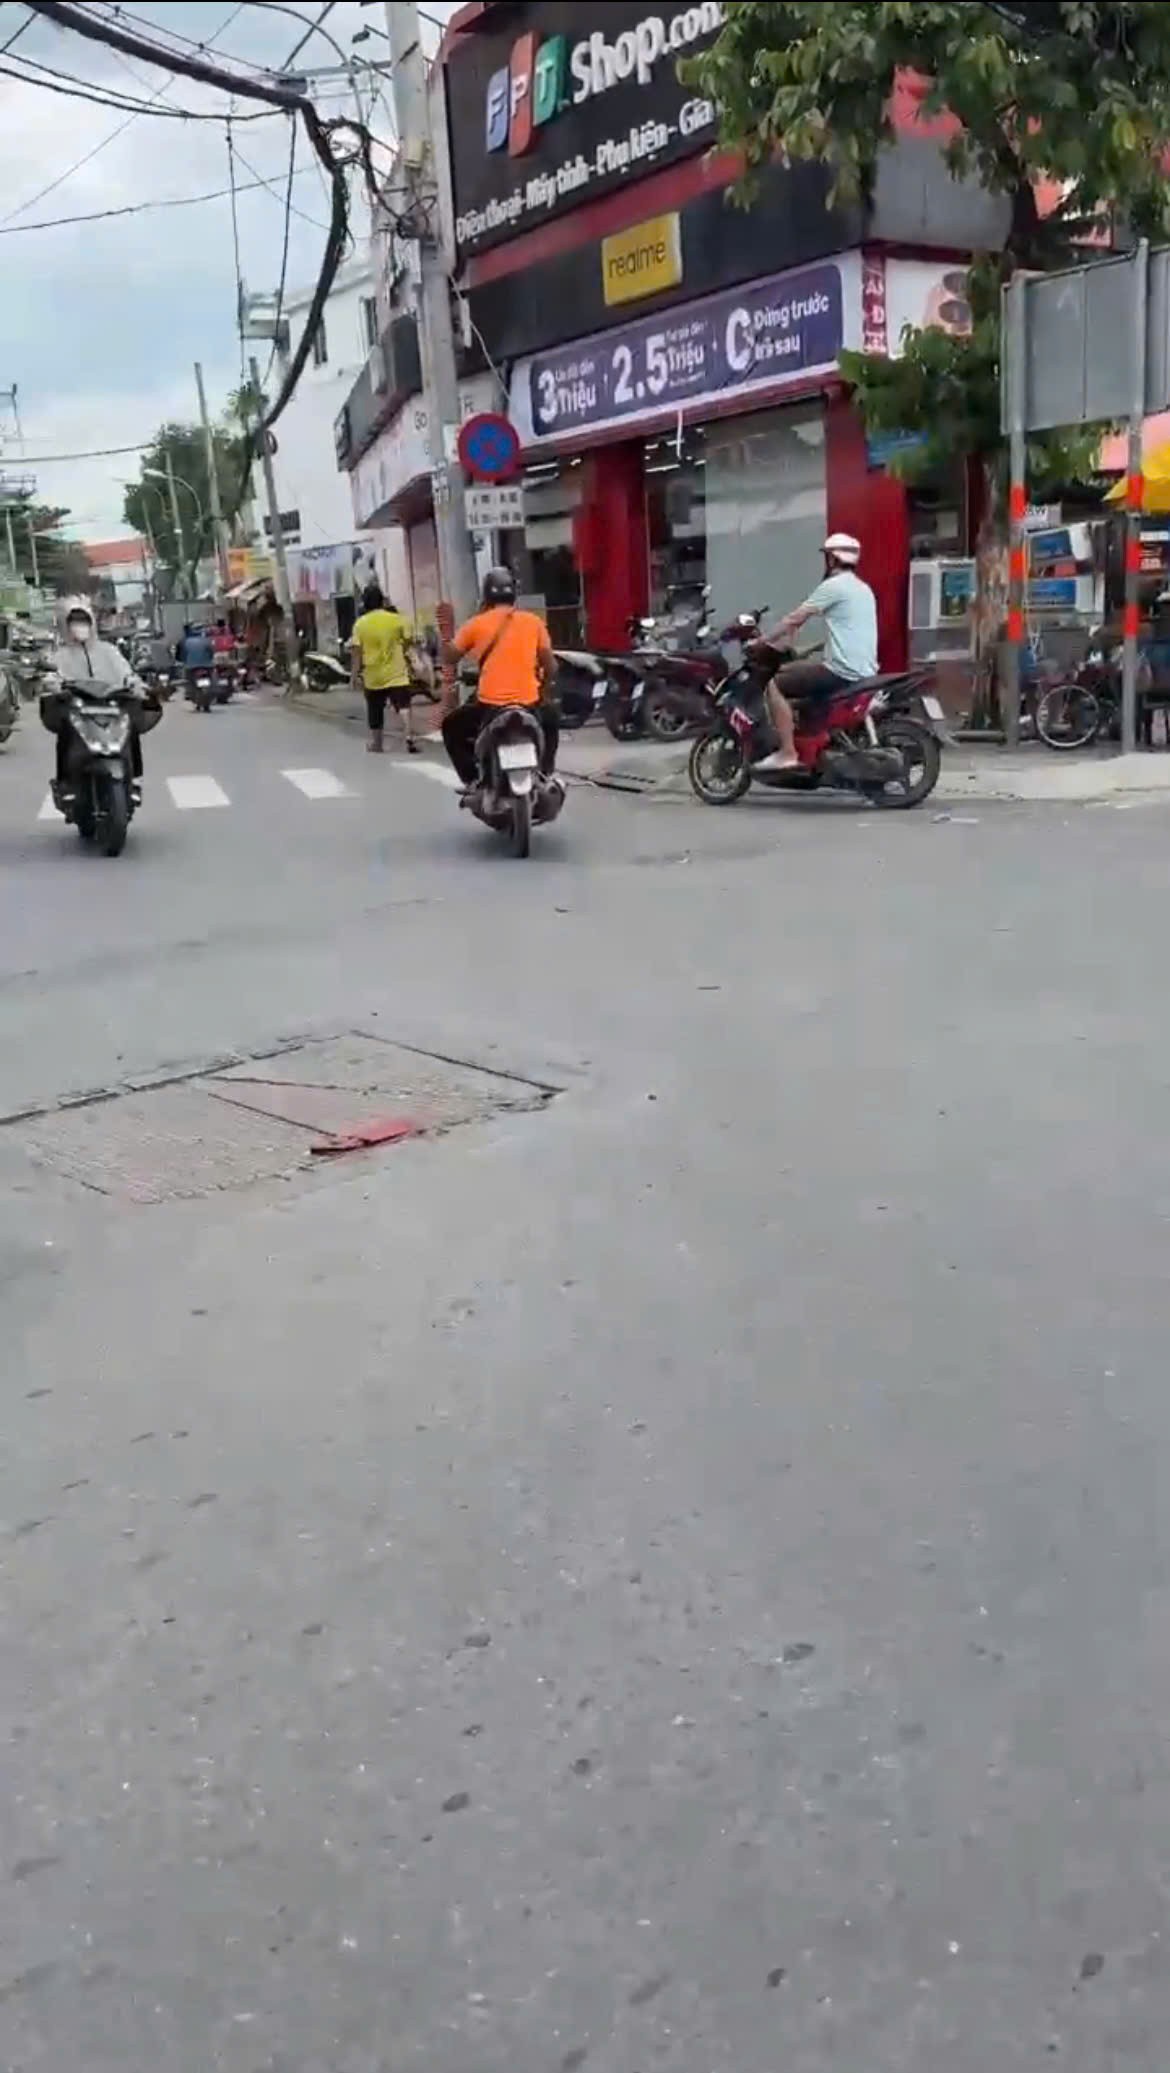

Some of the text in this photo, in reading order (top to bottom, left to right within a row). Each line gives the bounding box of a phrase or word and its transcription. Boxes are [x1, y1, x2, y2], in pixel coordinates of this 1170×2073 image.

[456, 98, 715, 243] Điện thoại Máy tính Phụ kiện Gia
[608, 241, 666, 279] realme
[612, 332, 705, 404] 2.5 Triệu
[774, 334, 800, 356] sau
[538, 368, 558, 424] 3
[557, 380, 597, 417] Triệu
